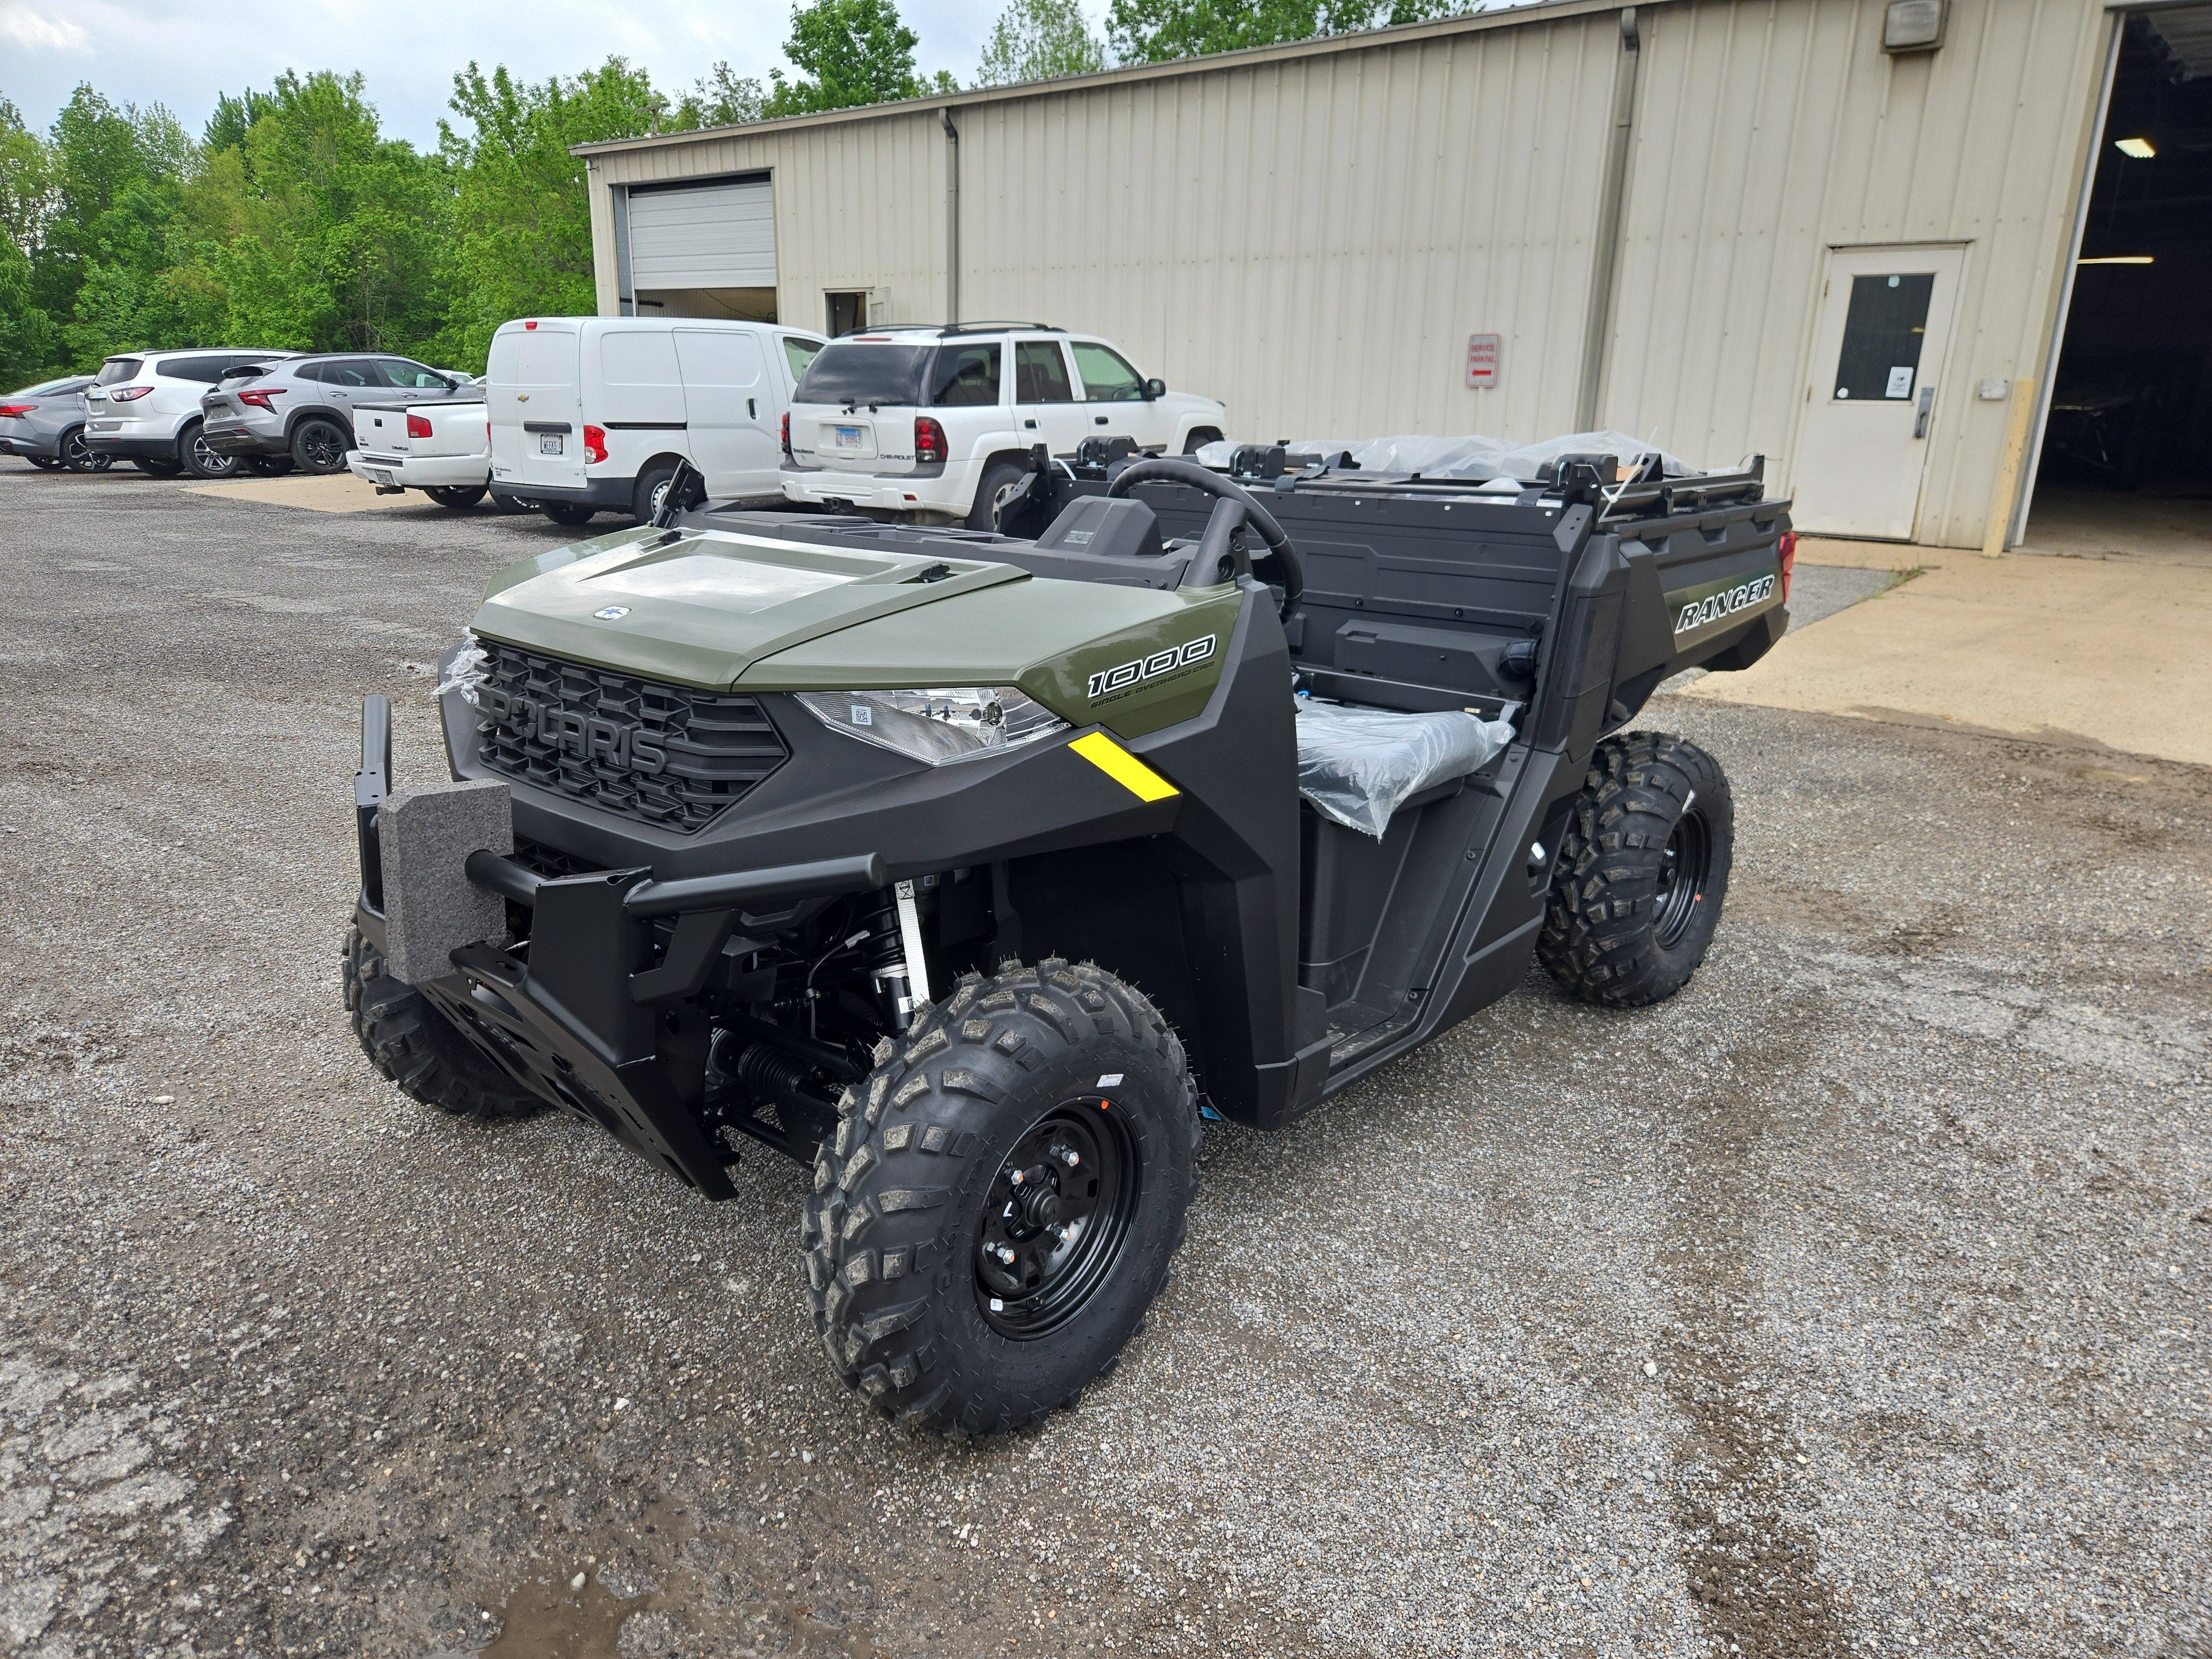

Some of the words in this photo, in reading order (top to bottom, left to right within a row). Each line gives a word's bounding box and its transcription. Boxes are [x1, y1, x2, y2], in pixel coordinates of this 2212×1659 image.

[1470, 355, 1494, 363] PARKING
[1471, 344, 1495, 352] SERVICE
[1066, 533, 1092, 542] EPS
[1675, 574, 1775, 634] RANGER
[1088, 634, 1217, 699] 1000
[1090, 690, 1133, 709] SINGLE
[1135, 671, 1191, 694] OVERHEAD
[1193, 661, 1216, 673] CAM
[488, 685, 667, 774] POLARIS
